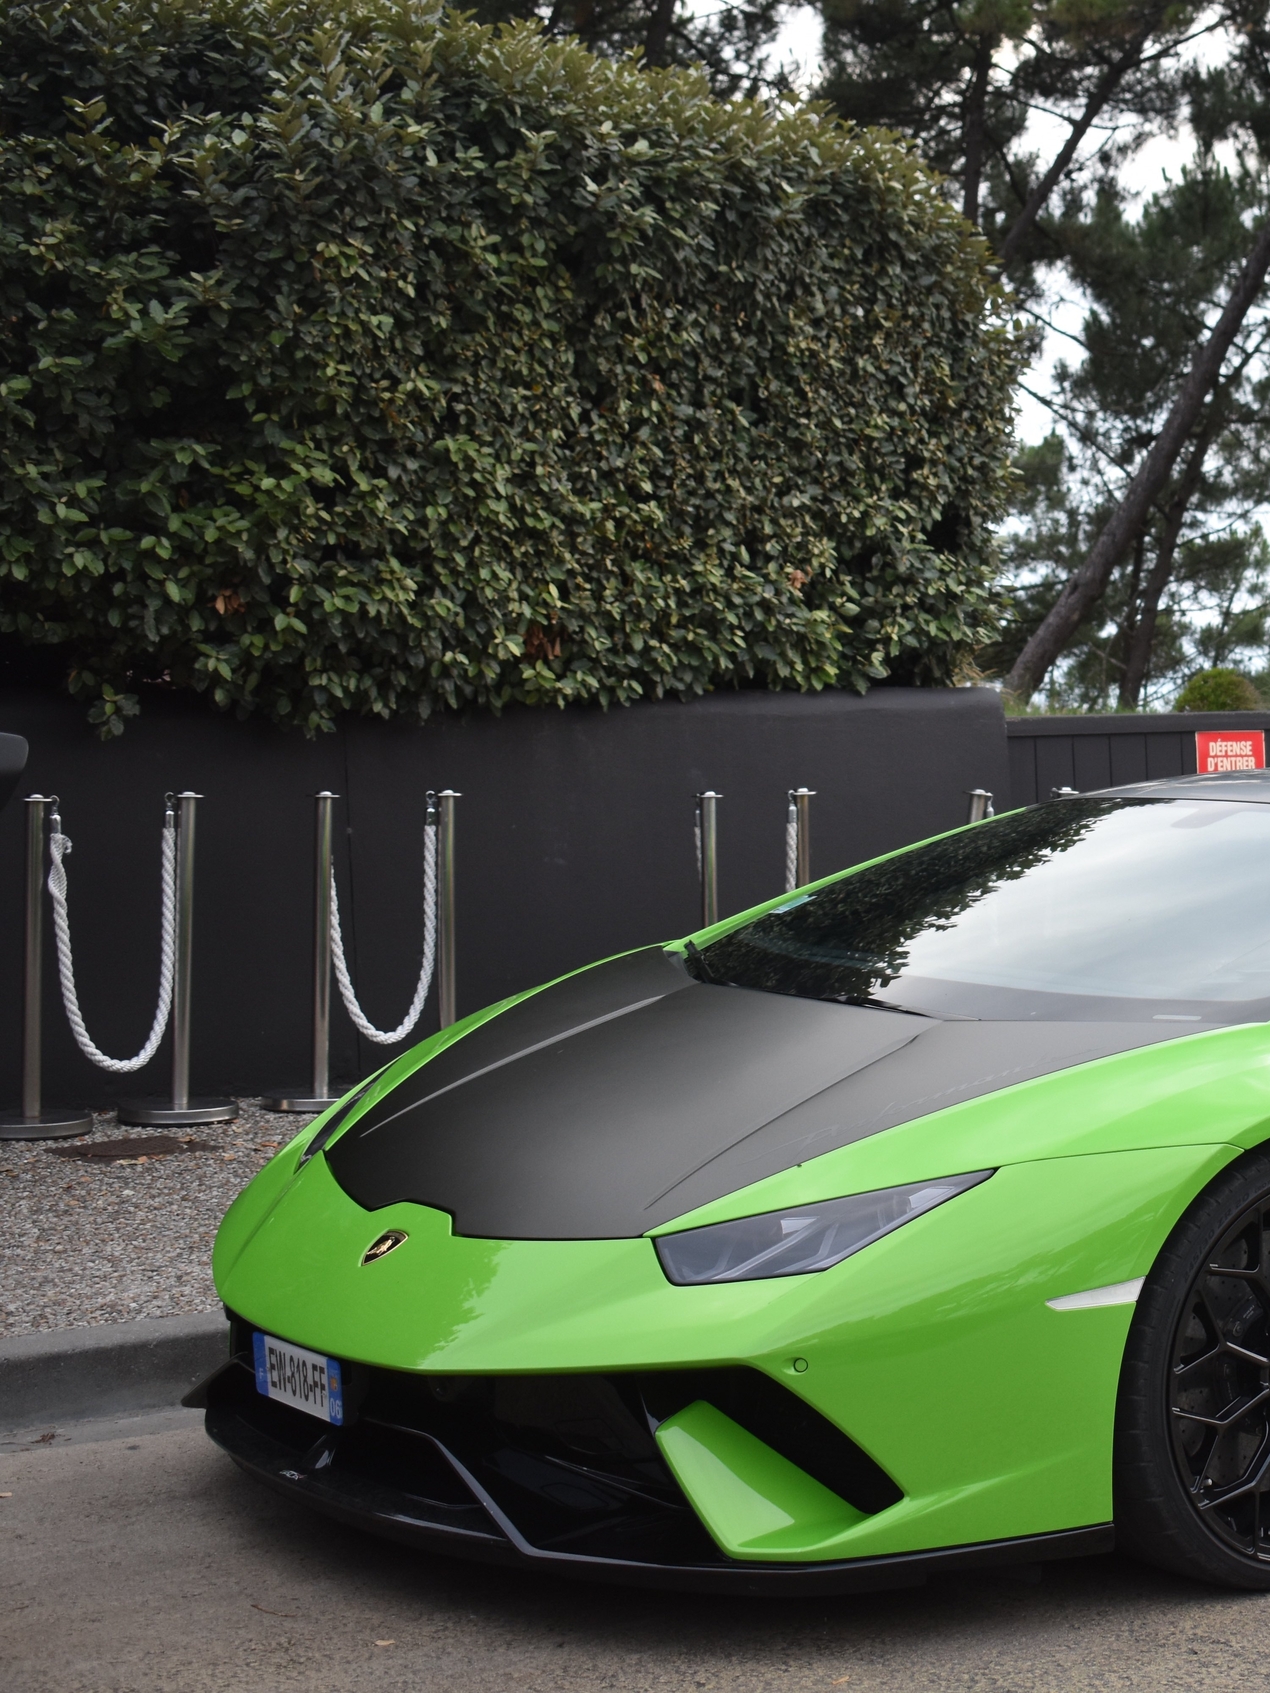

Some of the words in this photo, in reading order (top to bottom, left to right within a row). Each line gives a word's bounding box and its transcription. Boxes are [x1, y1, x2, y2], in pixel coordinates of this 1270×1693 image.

[1209, 738, 1253, 756] DÉFENSE
[1207, 756, 1256, 772] D'ENTRER
[268, 1346, 326, 1407] EW-818-FF
[330, 1398, 342, 1419] 06
